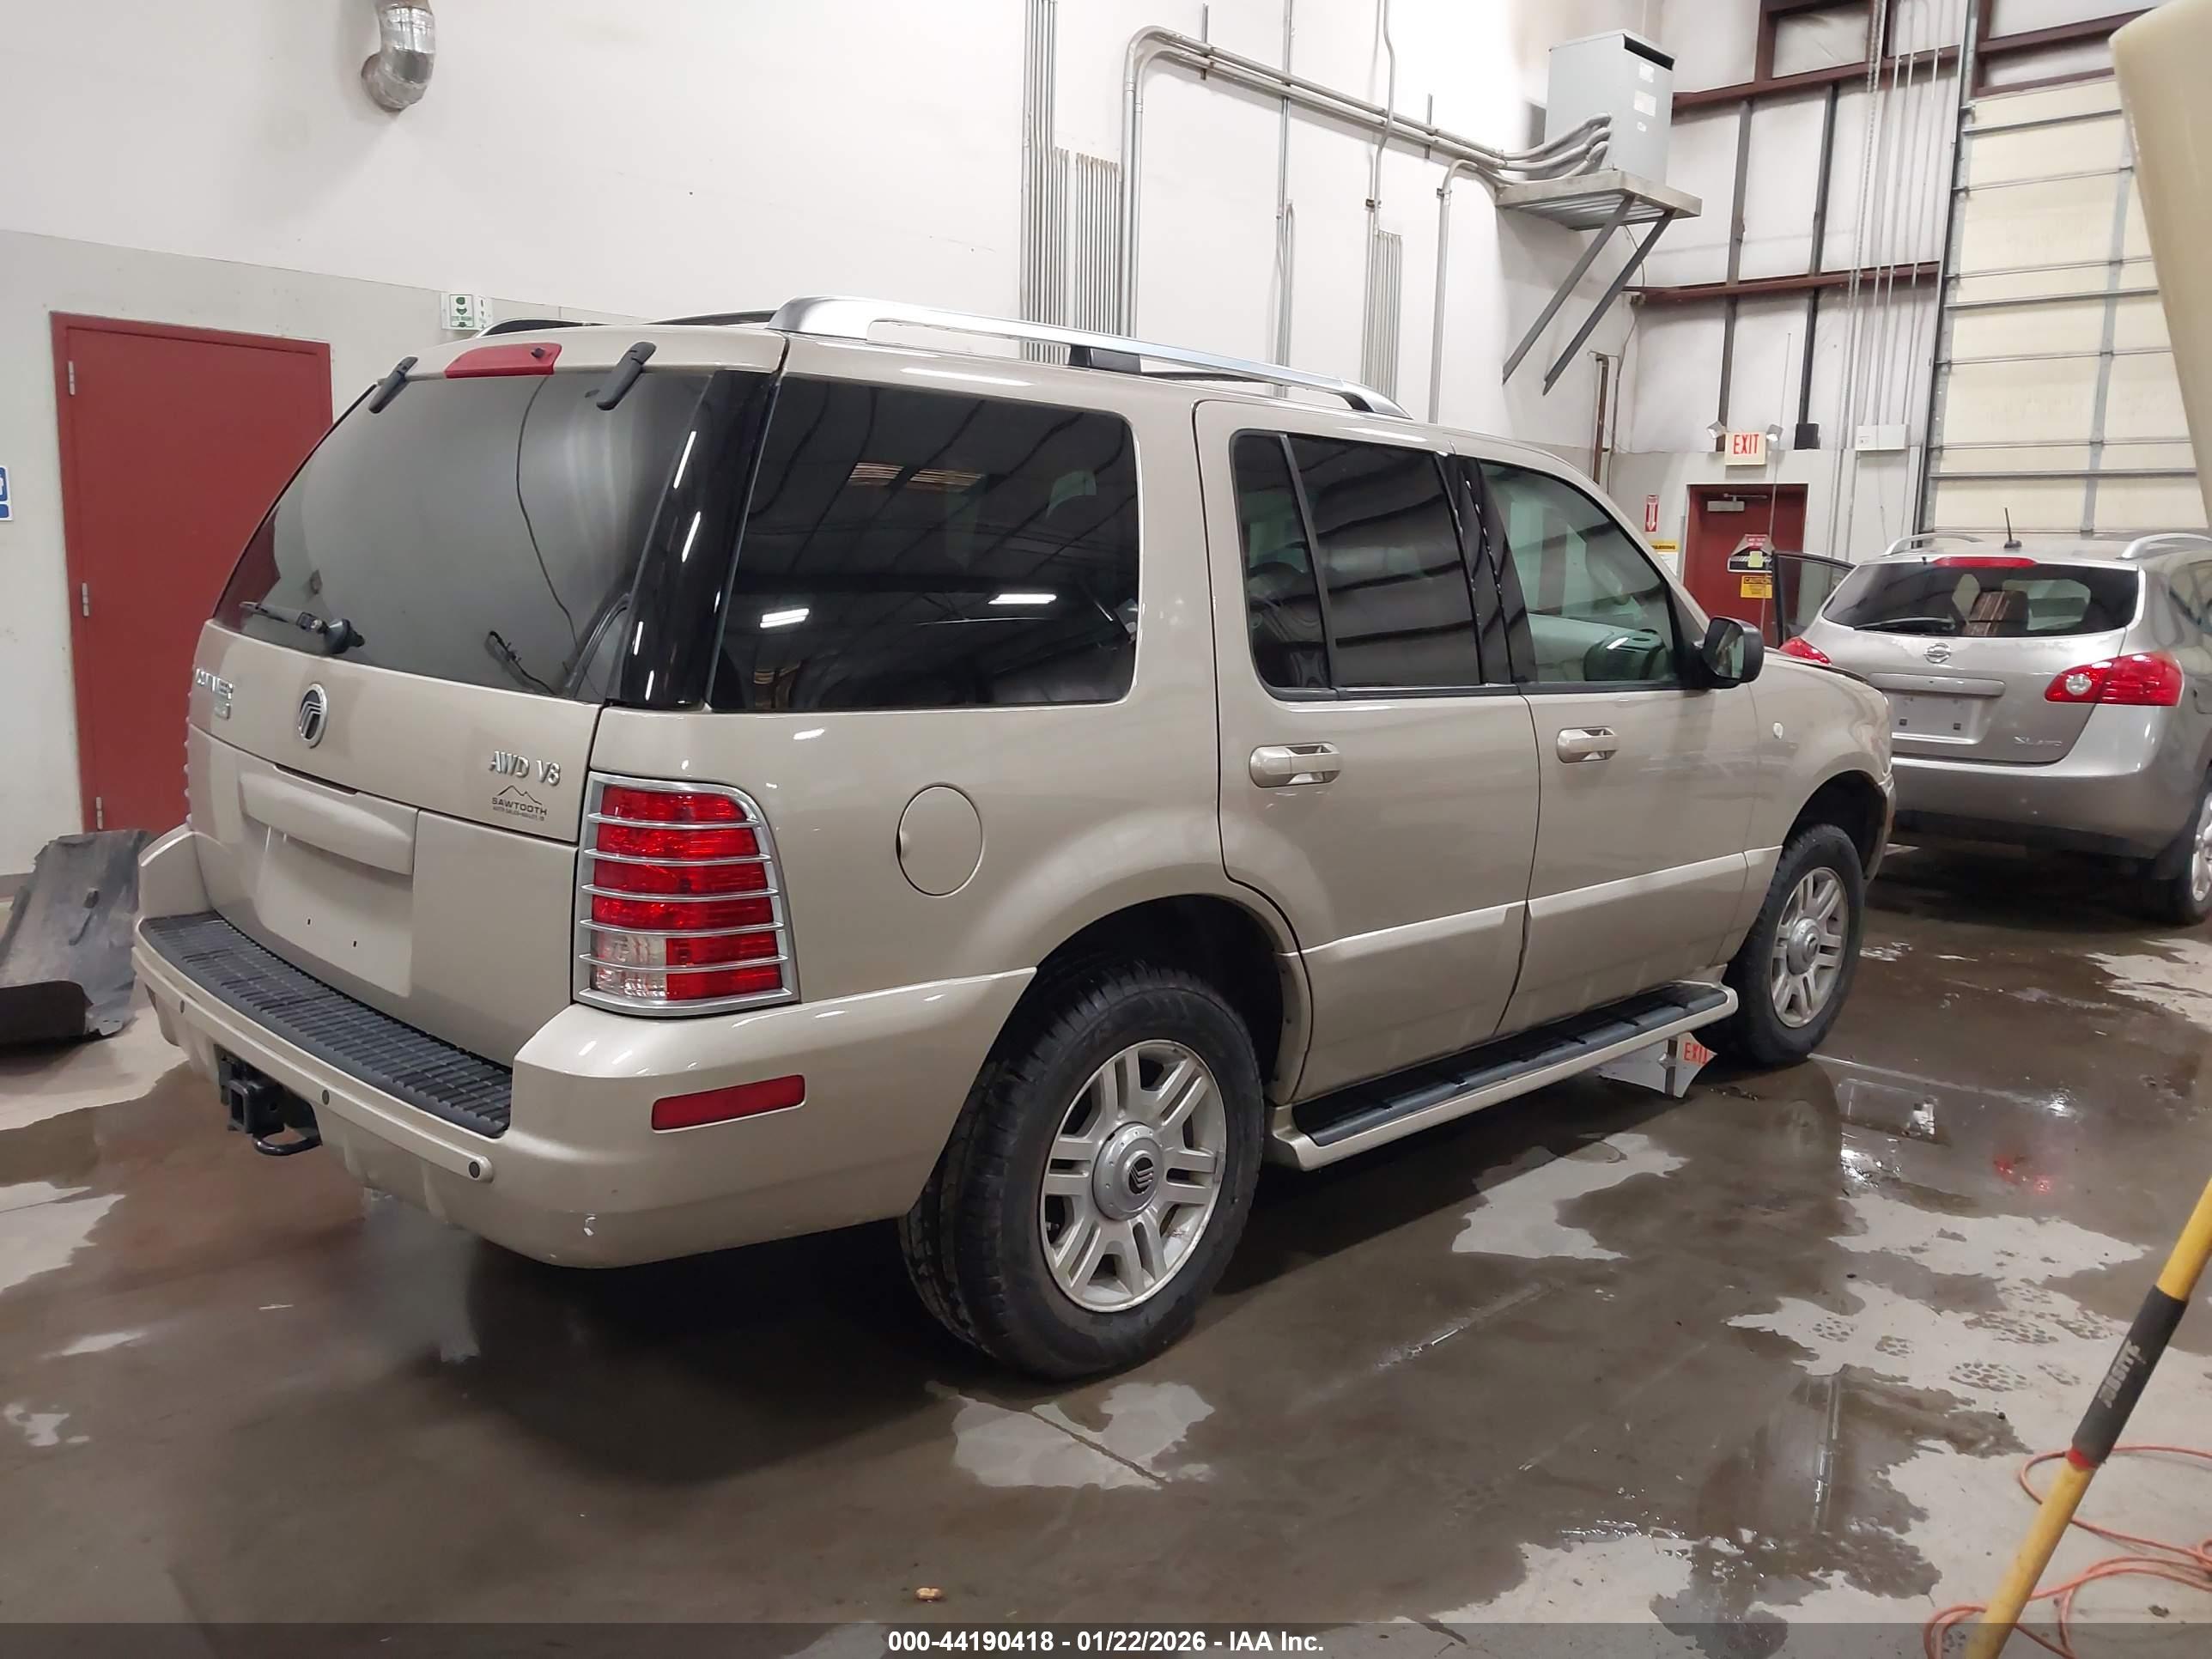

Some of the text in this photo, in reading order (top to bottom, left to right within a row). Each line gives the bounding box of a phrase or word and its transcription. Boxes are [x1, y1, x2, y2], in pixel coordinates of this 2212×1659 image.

[1733, 434, 1759, 454] EXIT
[488, 750, 561, 787] AWD V8
[491, 797, 548, 815] SAWTOOTH
